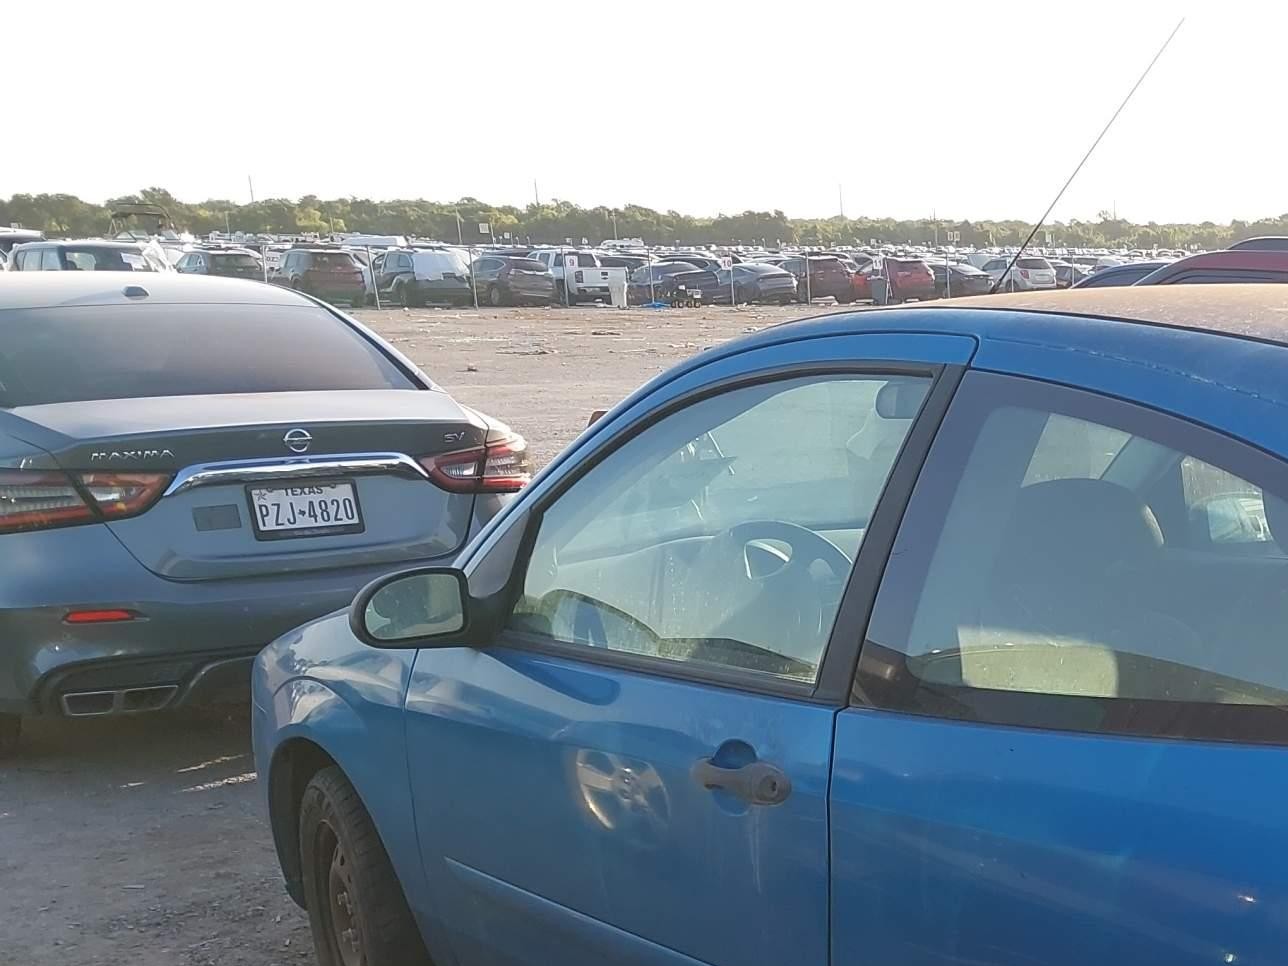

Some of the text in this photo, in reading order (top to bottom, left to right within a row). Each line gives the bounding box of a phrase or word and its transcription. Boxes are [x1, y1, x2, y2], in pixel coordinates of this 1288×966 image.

[444, 431, 465, 443] SV
[91, 449, 175, 461] MAXIMA
[283, 486, 324, 497] TEXAS
